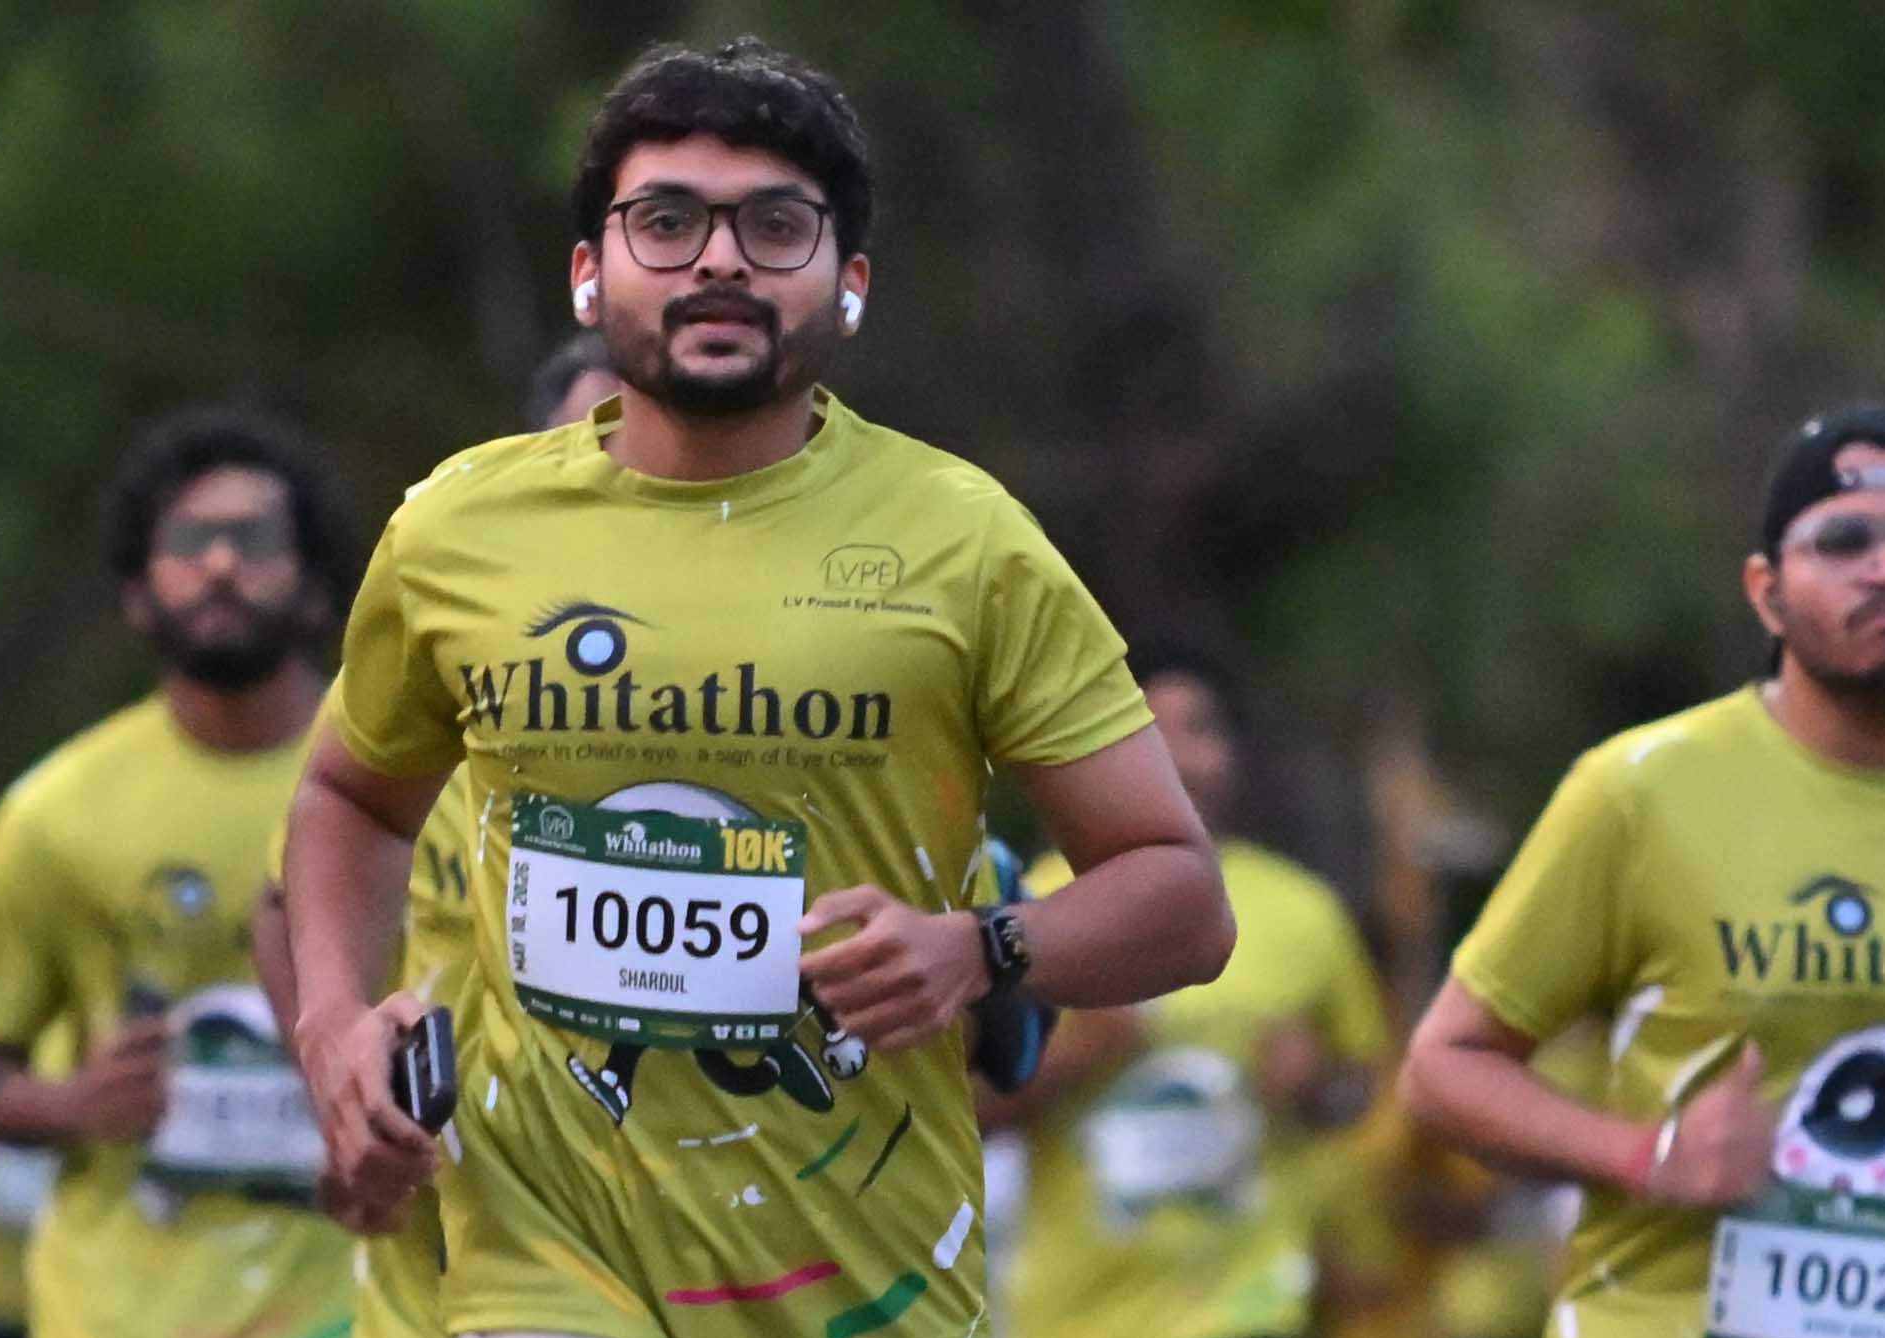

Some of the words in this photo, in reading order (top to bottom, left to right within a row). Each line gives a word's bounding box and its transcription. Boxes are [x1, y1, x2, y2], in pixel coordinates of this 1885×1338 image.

[459, 657, 892, 741] Whitathon
[605, 831, 702, 859] Whitathon
[722, 827, 788, 873] 10K
[556, 885, 770, 960] 10059
[618, 967, 688, 994] SHARDUL
